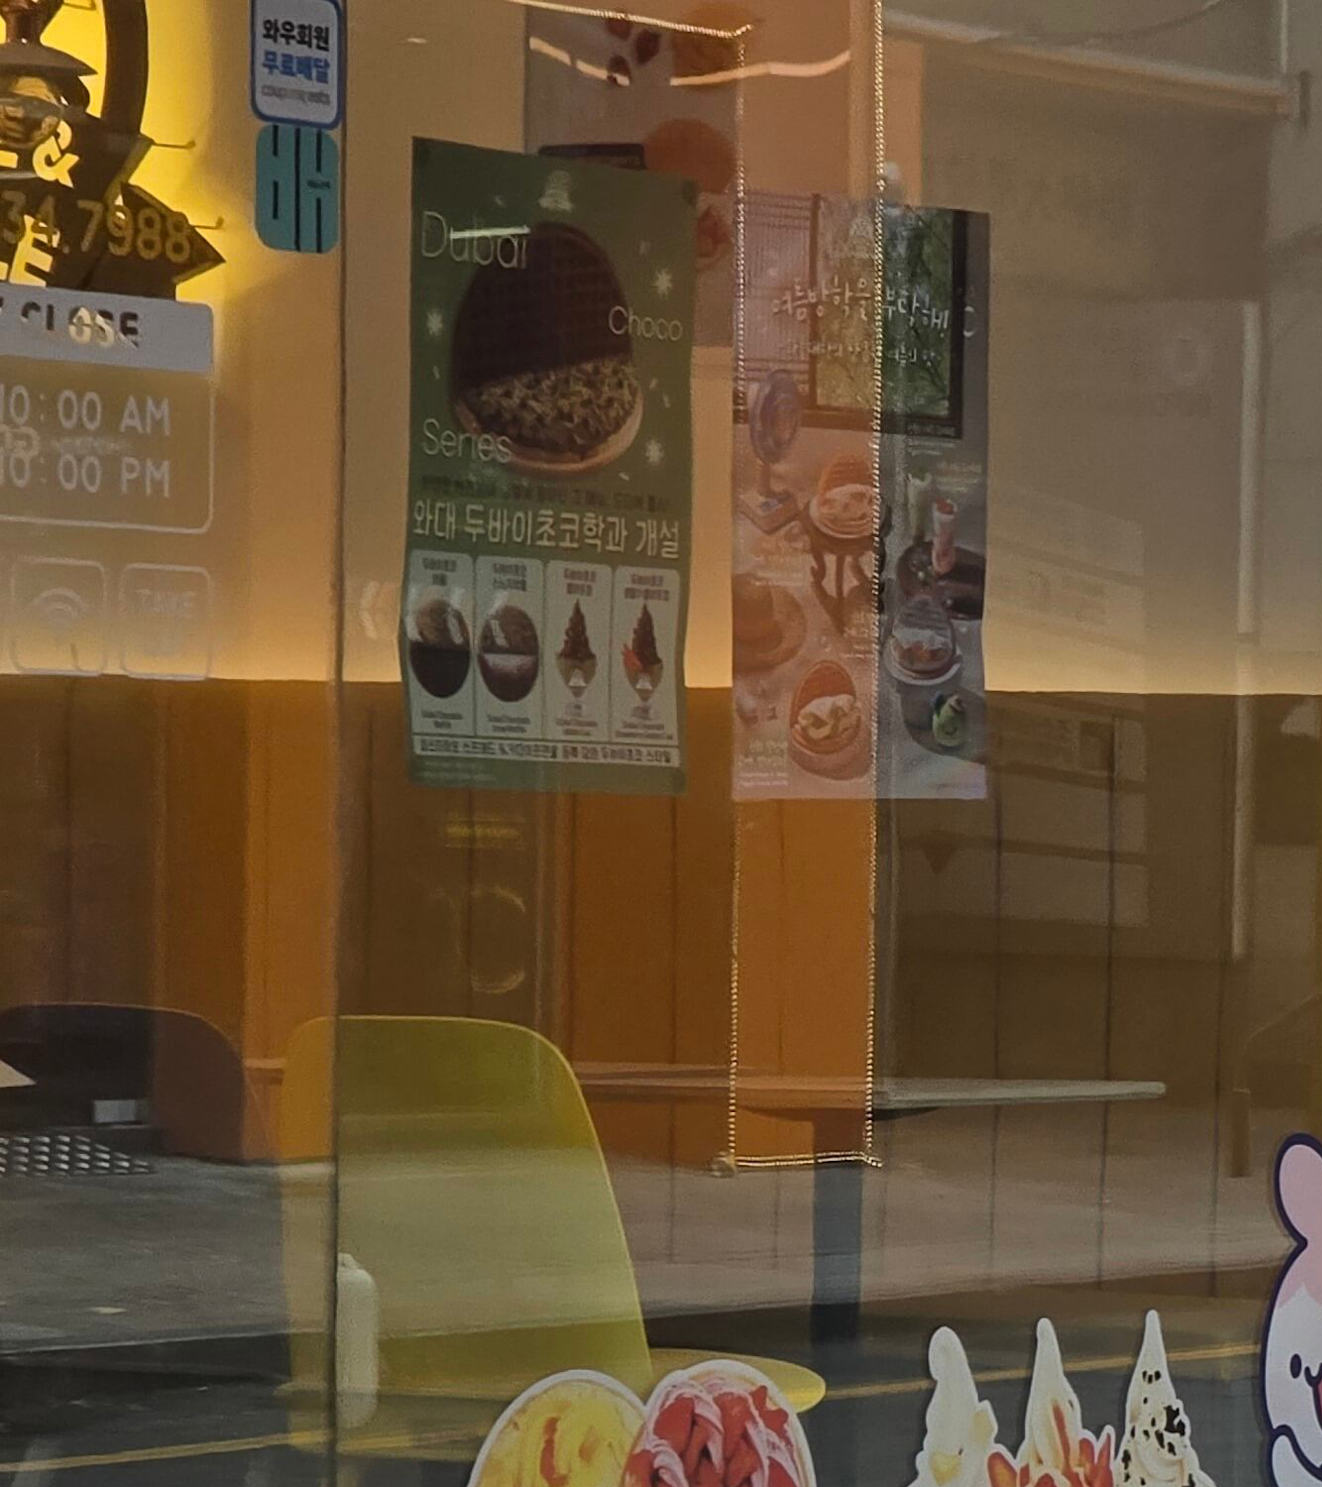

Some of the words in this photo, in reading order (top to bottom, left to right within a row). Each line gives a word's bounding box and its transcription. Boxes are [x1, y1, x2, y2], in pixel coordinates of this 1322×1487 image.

[262, 19, 329, 52] 와우회원
[421, 210, 528, 270] Dubai
[608, 304, 684, 342] Choco
[119, 395, 171, 437] AM
[423, 418, 513, 464] Series
[120, 456, 171, 499] PM
[412, 500, 456, 541] 와대
[463, 502, 629, 554] 두바이초코학과
[635, 518, 681, 561] 개설
